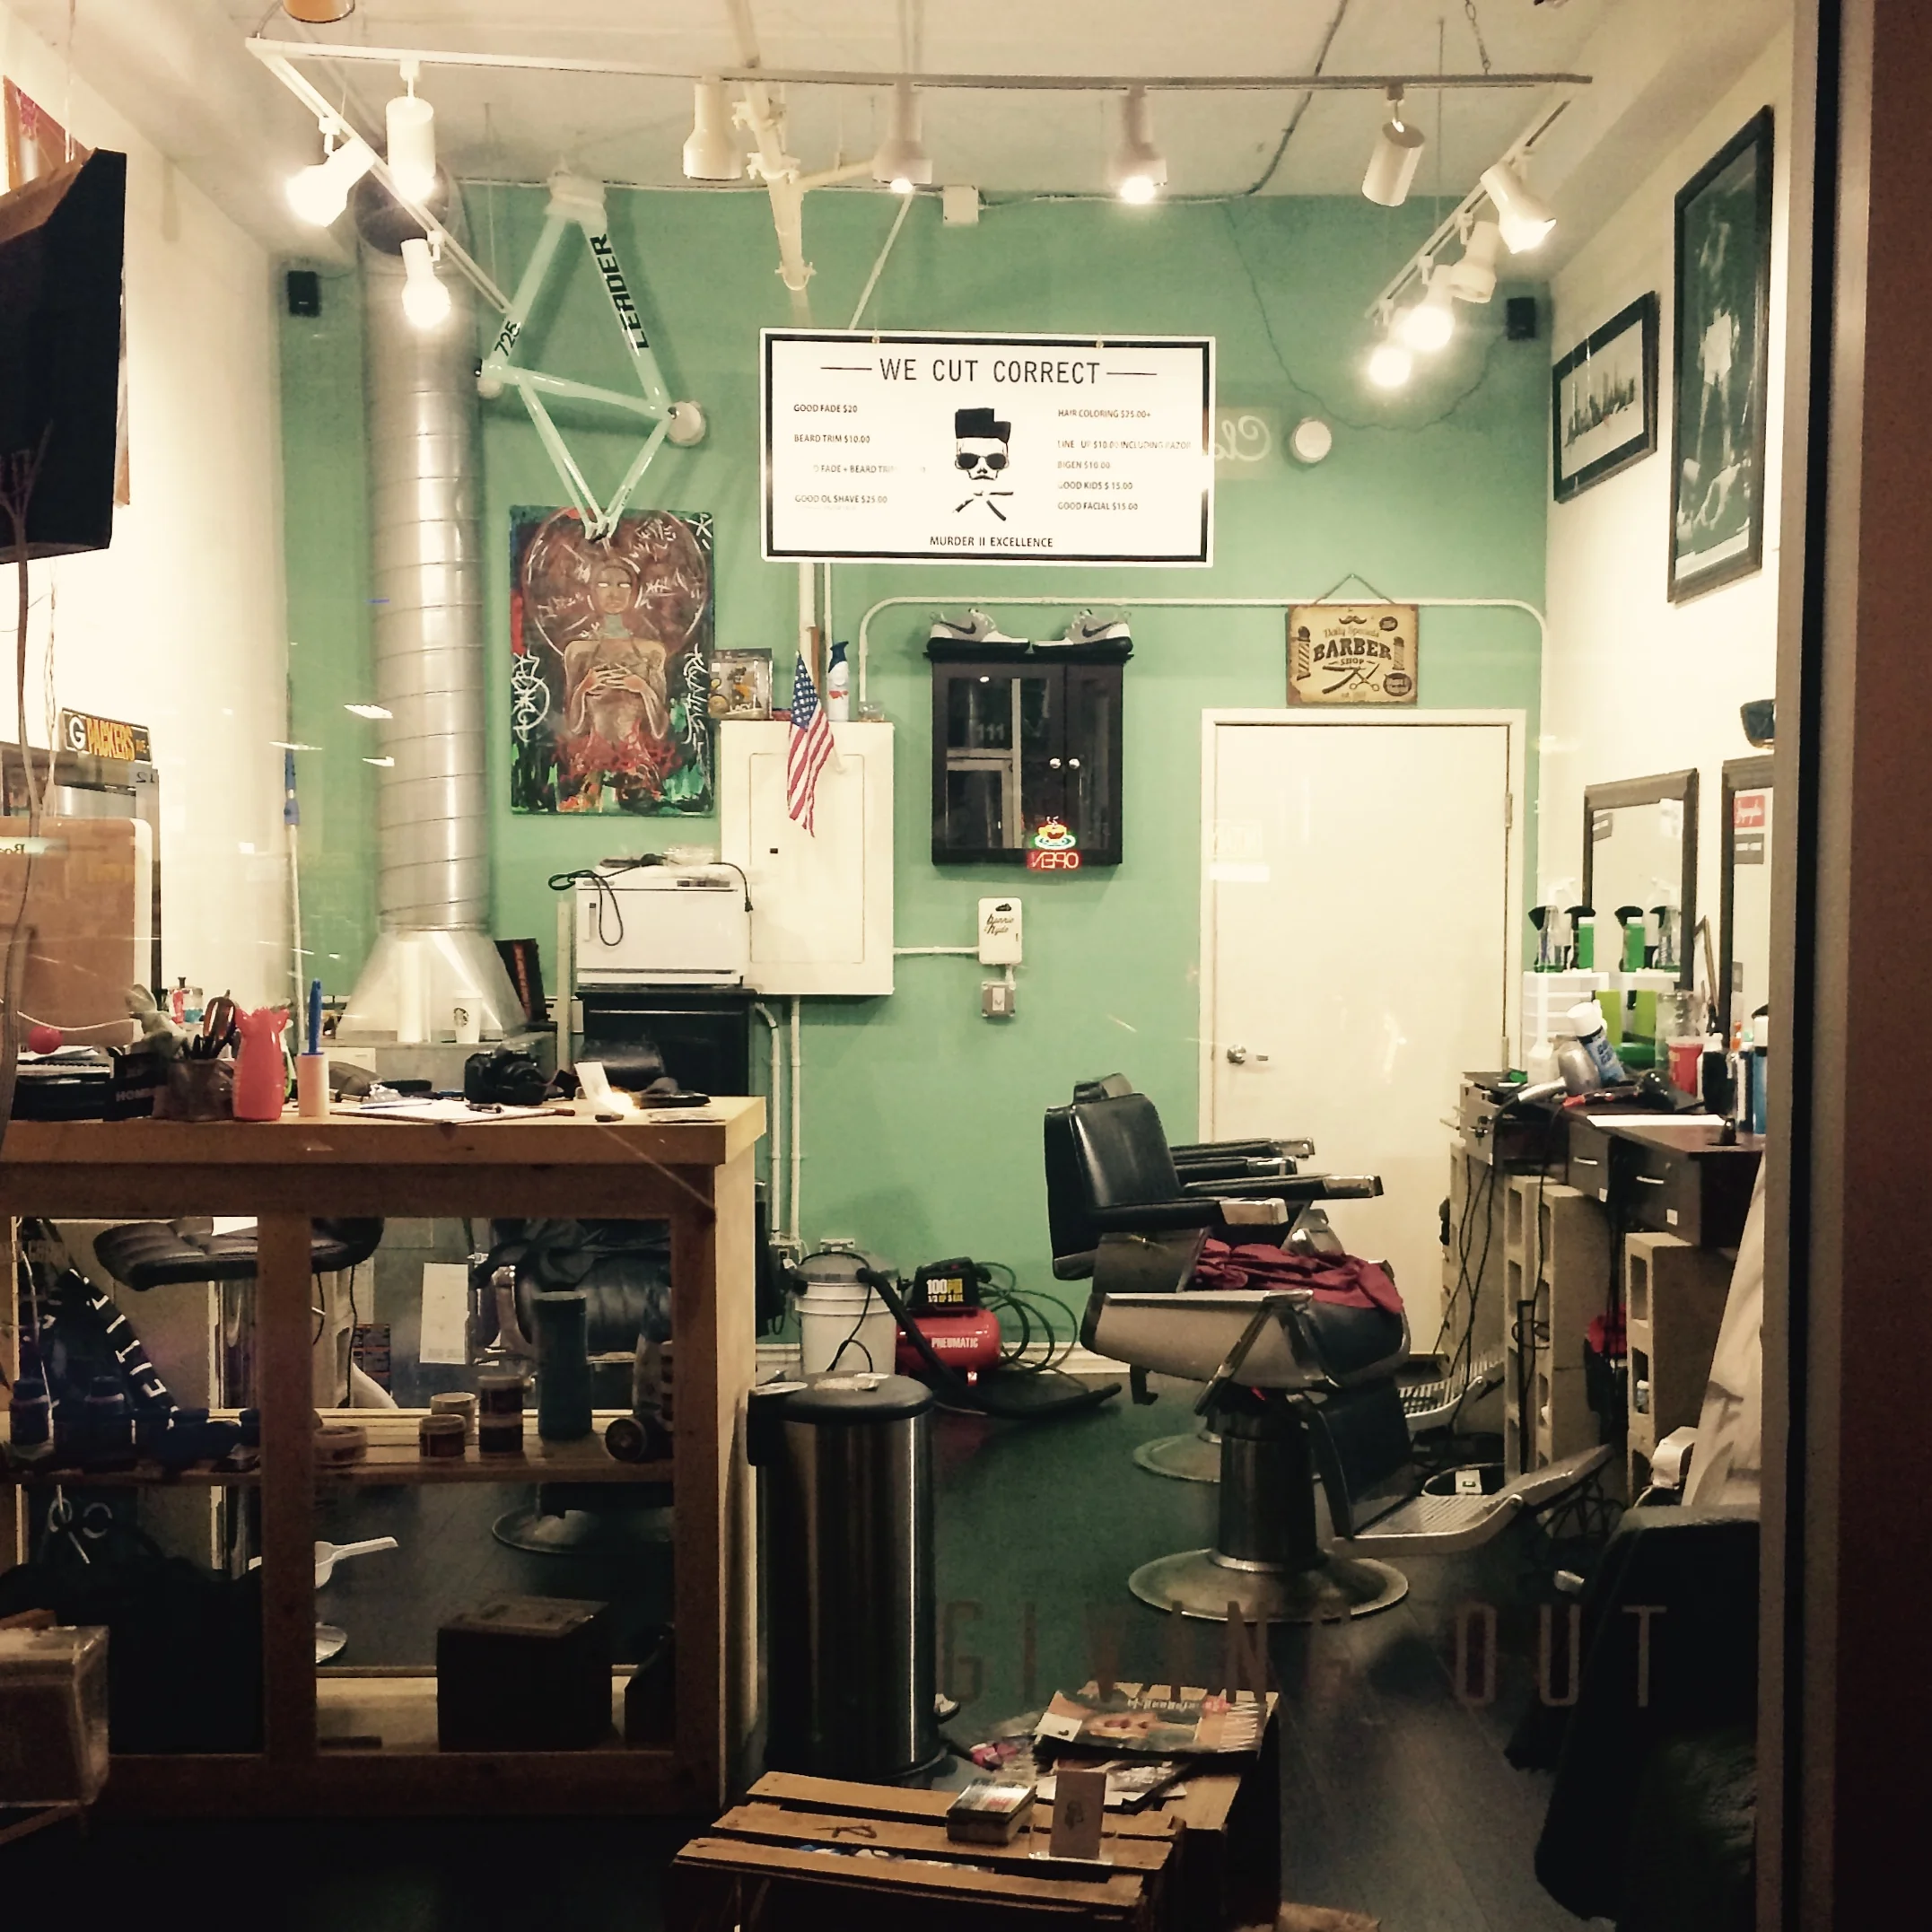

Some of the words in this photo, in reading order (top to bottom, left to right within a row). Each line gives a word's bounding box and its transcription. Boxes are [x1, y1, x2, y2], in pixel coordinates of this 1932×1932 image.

[590, 233, 650, 349] LEADER
[494, 320, 520, 356] 725
[879, 358, 917, 380] WE
[932, 359, 978, 382] CUT
[993, 360, 1100, 384] CORRECT
[793, 404, 819, 413] GOOD
[820, 405, 841, 413] FADE
[843, 405, 858, 414] $20
[1058, 409, 1078, 417] HAIR
[1079, 409, 1119, 418] COLORING
[794, 434, 821, 442] BEARD
[822, 434, 842, 442] TRIM
[844, 435, 870, 443] $10.00
[820, 465, 842, 473] FADE
[849, 465, 877, 474] BEARD
[1057, 460, 1082, 469] BIGEN
[1083, 481, 1103, 490] KIDS
[794, 494, 820, 503] GOOD
[820, 494, 833, 503] OL
[833, 494, 859, 503] SHAVE
[1057, 502, 1082, 511] GOOD
[1083, 502, 1111, 511] FACIAL
[930, 536, 975, 546] MURDER
[979, 537, 986, 546] II
[990, 537, 1053, 547] EXCELLENCE
[1313, 637, 1392, 662] BARBER
[1341, 657, 1365, 665] SHOP
[86, 718, 135, 761] PACKERS
[931, 1337, 978, 1348] PNEUMATIC
[1456, 1603, 1667, 1707] OUT
